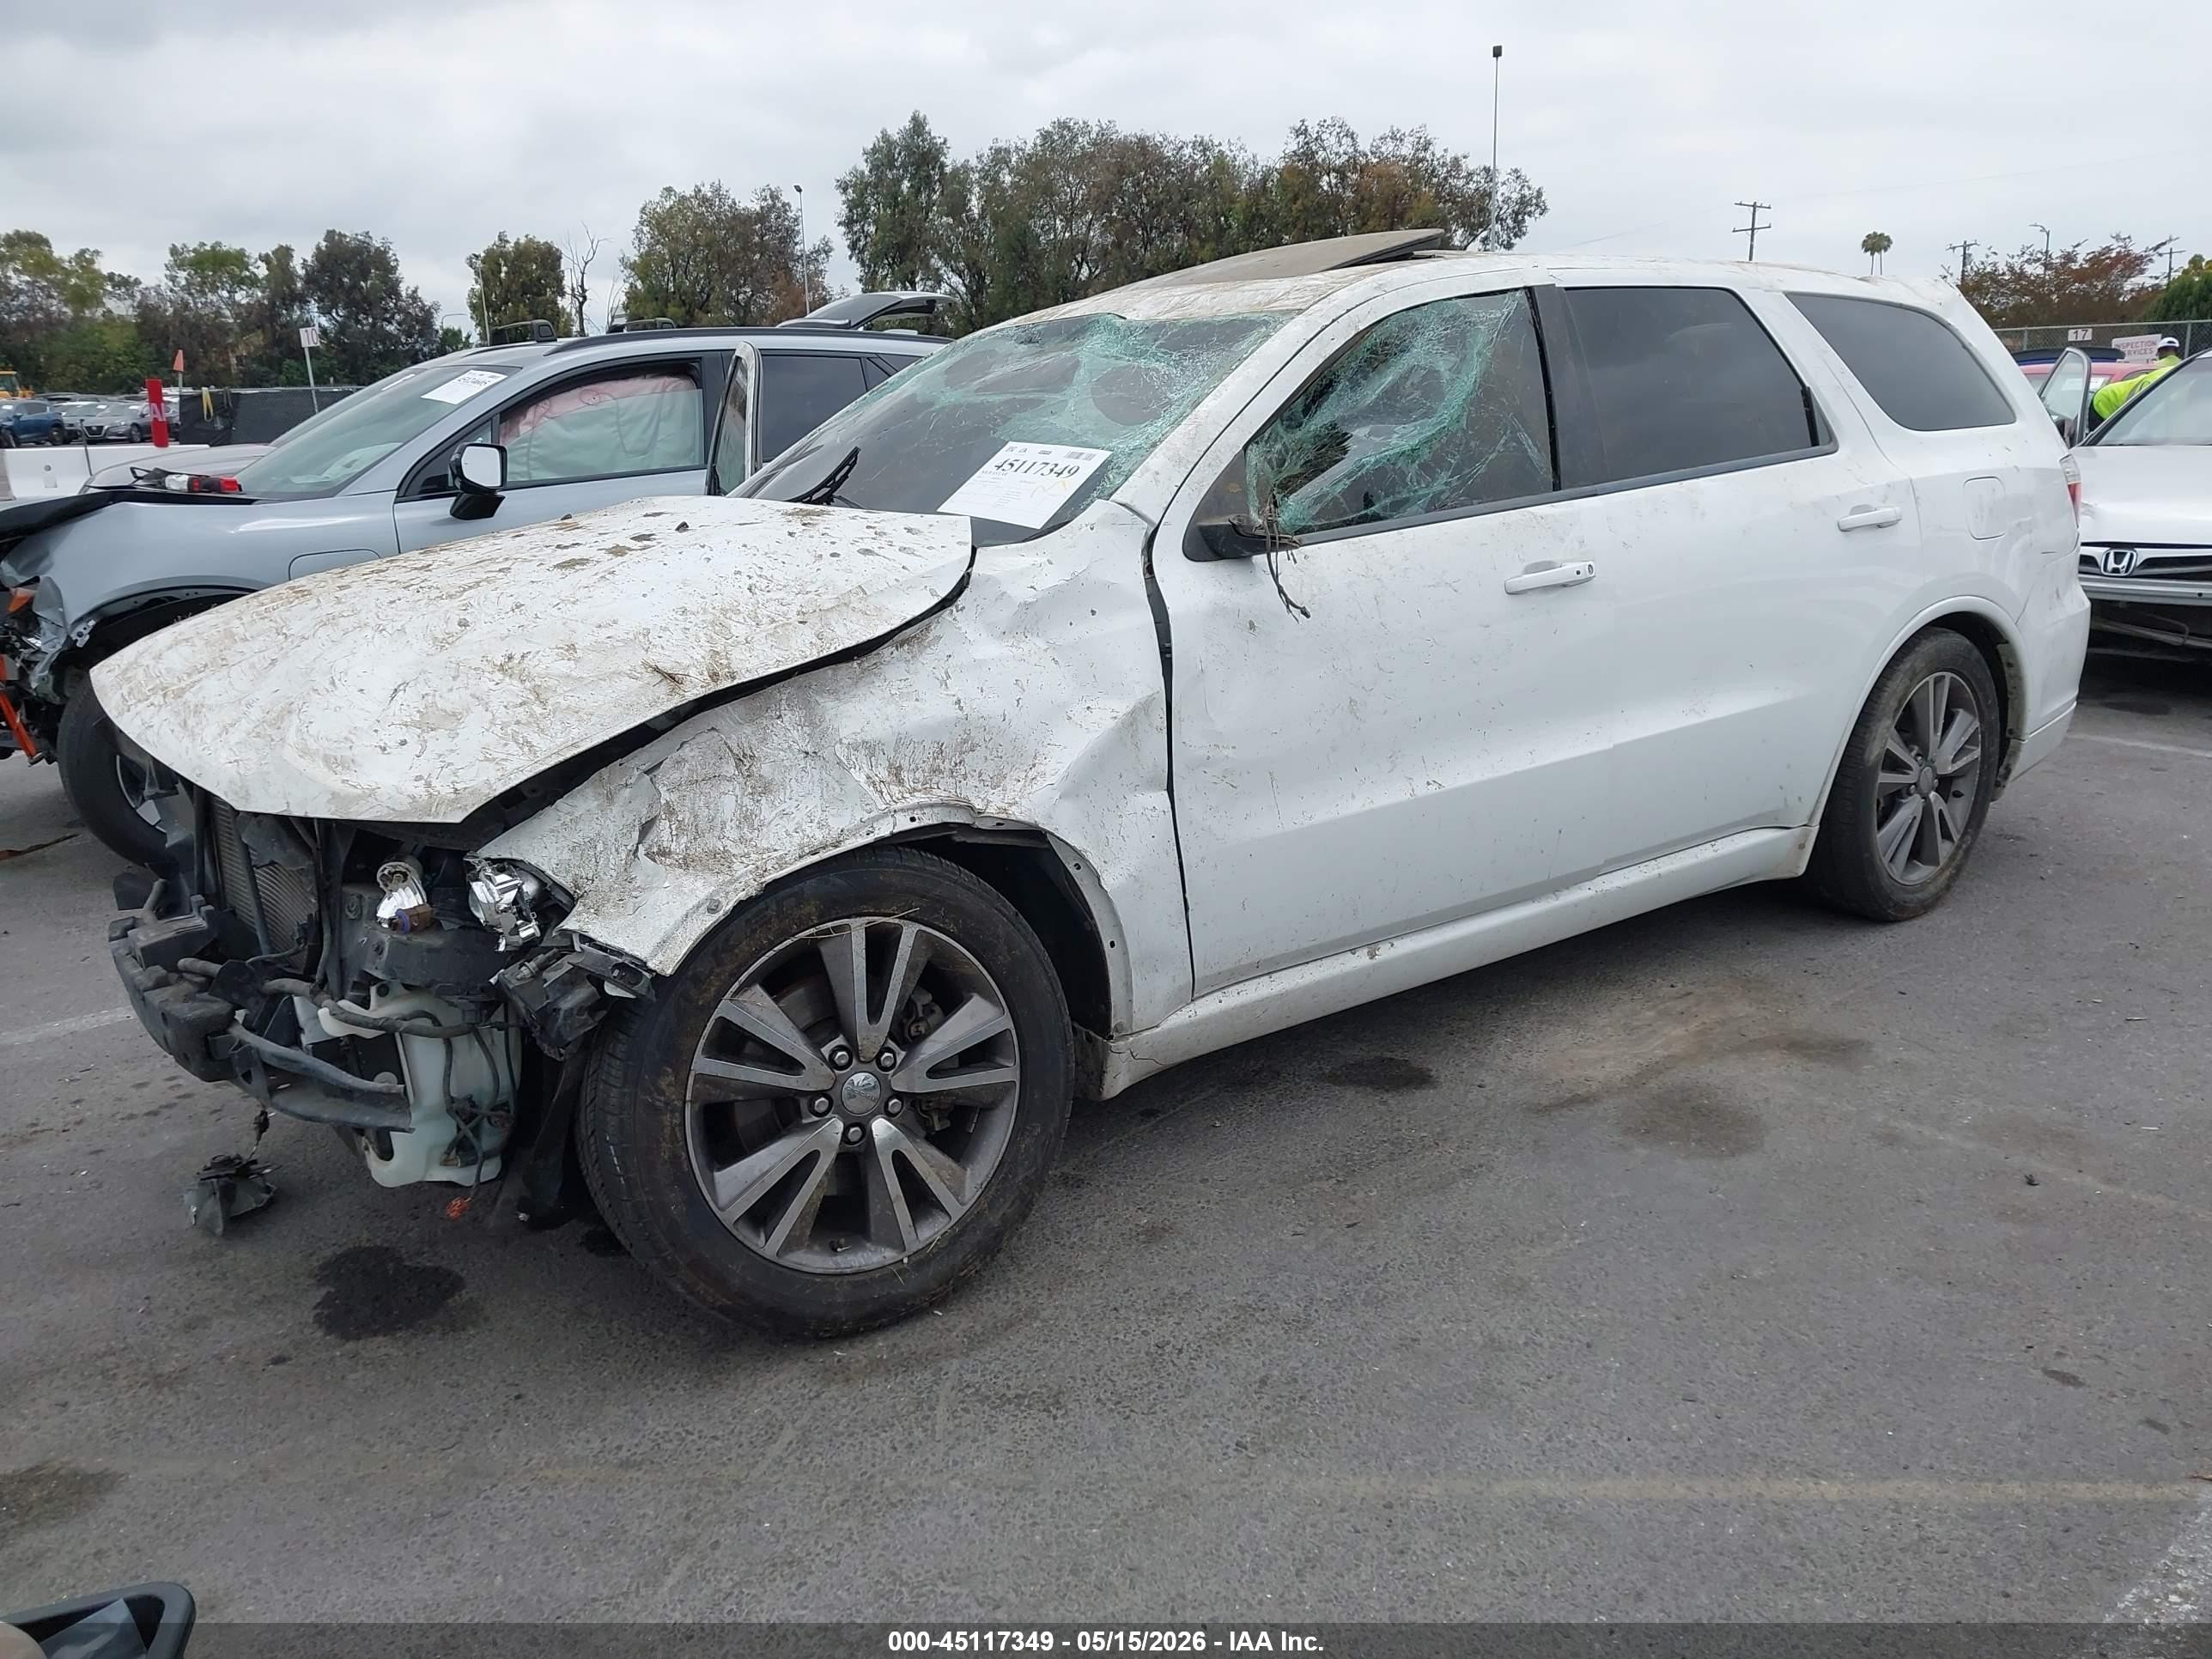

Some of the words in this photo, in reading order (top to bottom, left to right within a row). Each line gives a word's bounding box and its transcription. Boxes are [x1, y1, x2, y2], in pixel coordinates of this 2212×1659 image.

[305, 328, 319, 345] 10
[2074, 330, 2088, 340] 17
[994, 458, 1080, 479] 45117349
